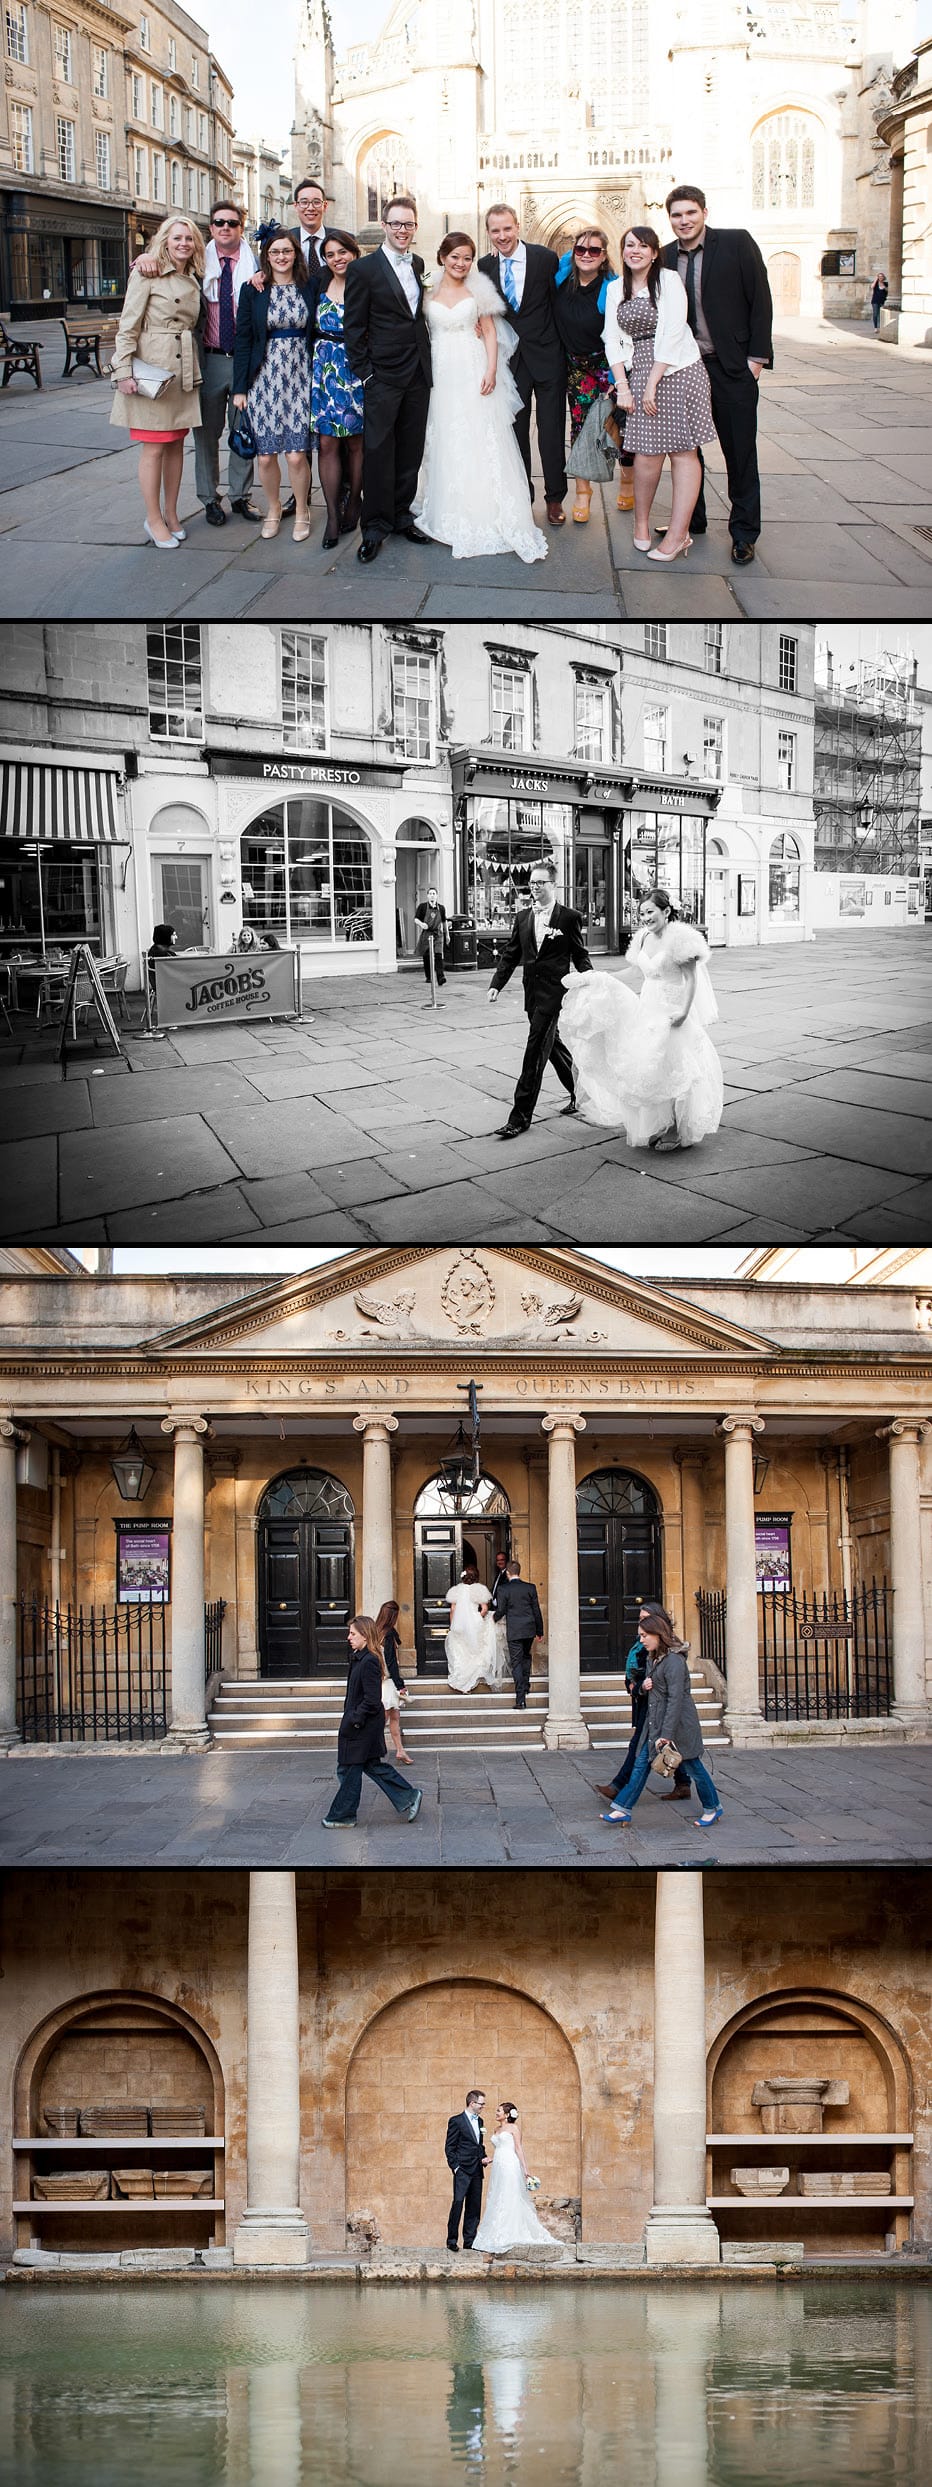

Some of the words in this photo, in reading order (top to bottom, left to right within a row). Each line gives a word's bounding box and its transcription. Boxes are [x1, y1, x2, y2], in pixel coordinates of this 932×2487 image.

[263, 763, 307, 779] PASTY
[310, 768, 361, 784] PRESTO
[510, 777, 549, 792] JACKS
[603, 789, 612, 799] of
[660, 795, 686, 807] BATH
[177, 841, 186, 851] 7
[185, 966, 266, 1011] JACOB'S
[207, 997, 235, 1013] COFFEE
[235, 991, 260, 1004] HOUSE
[356, 1378, 410, 1394] AND
[515, 1378, 609, 1396] QUEEN'S
